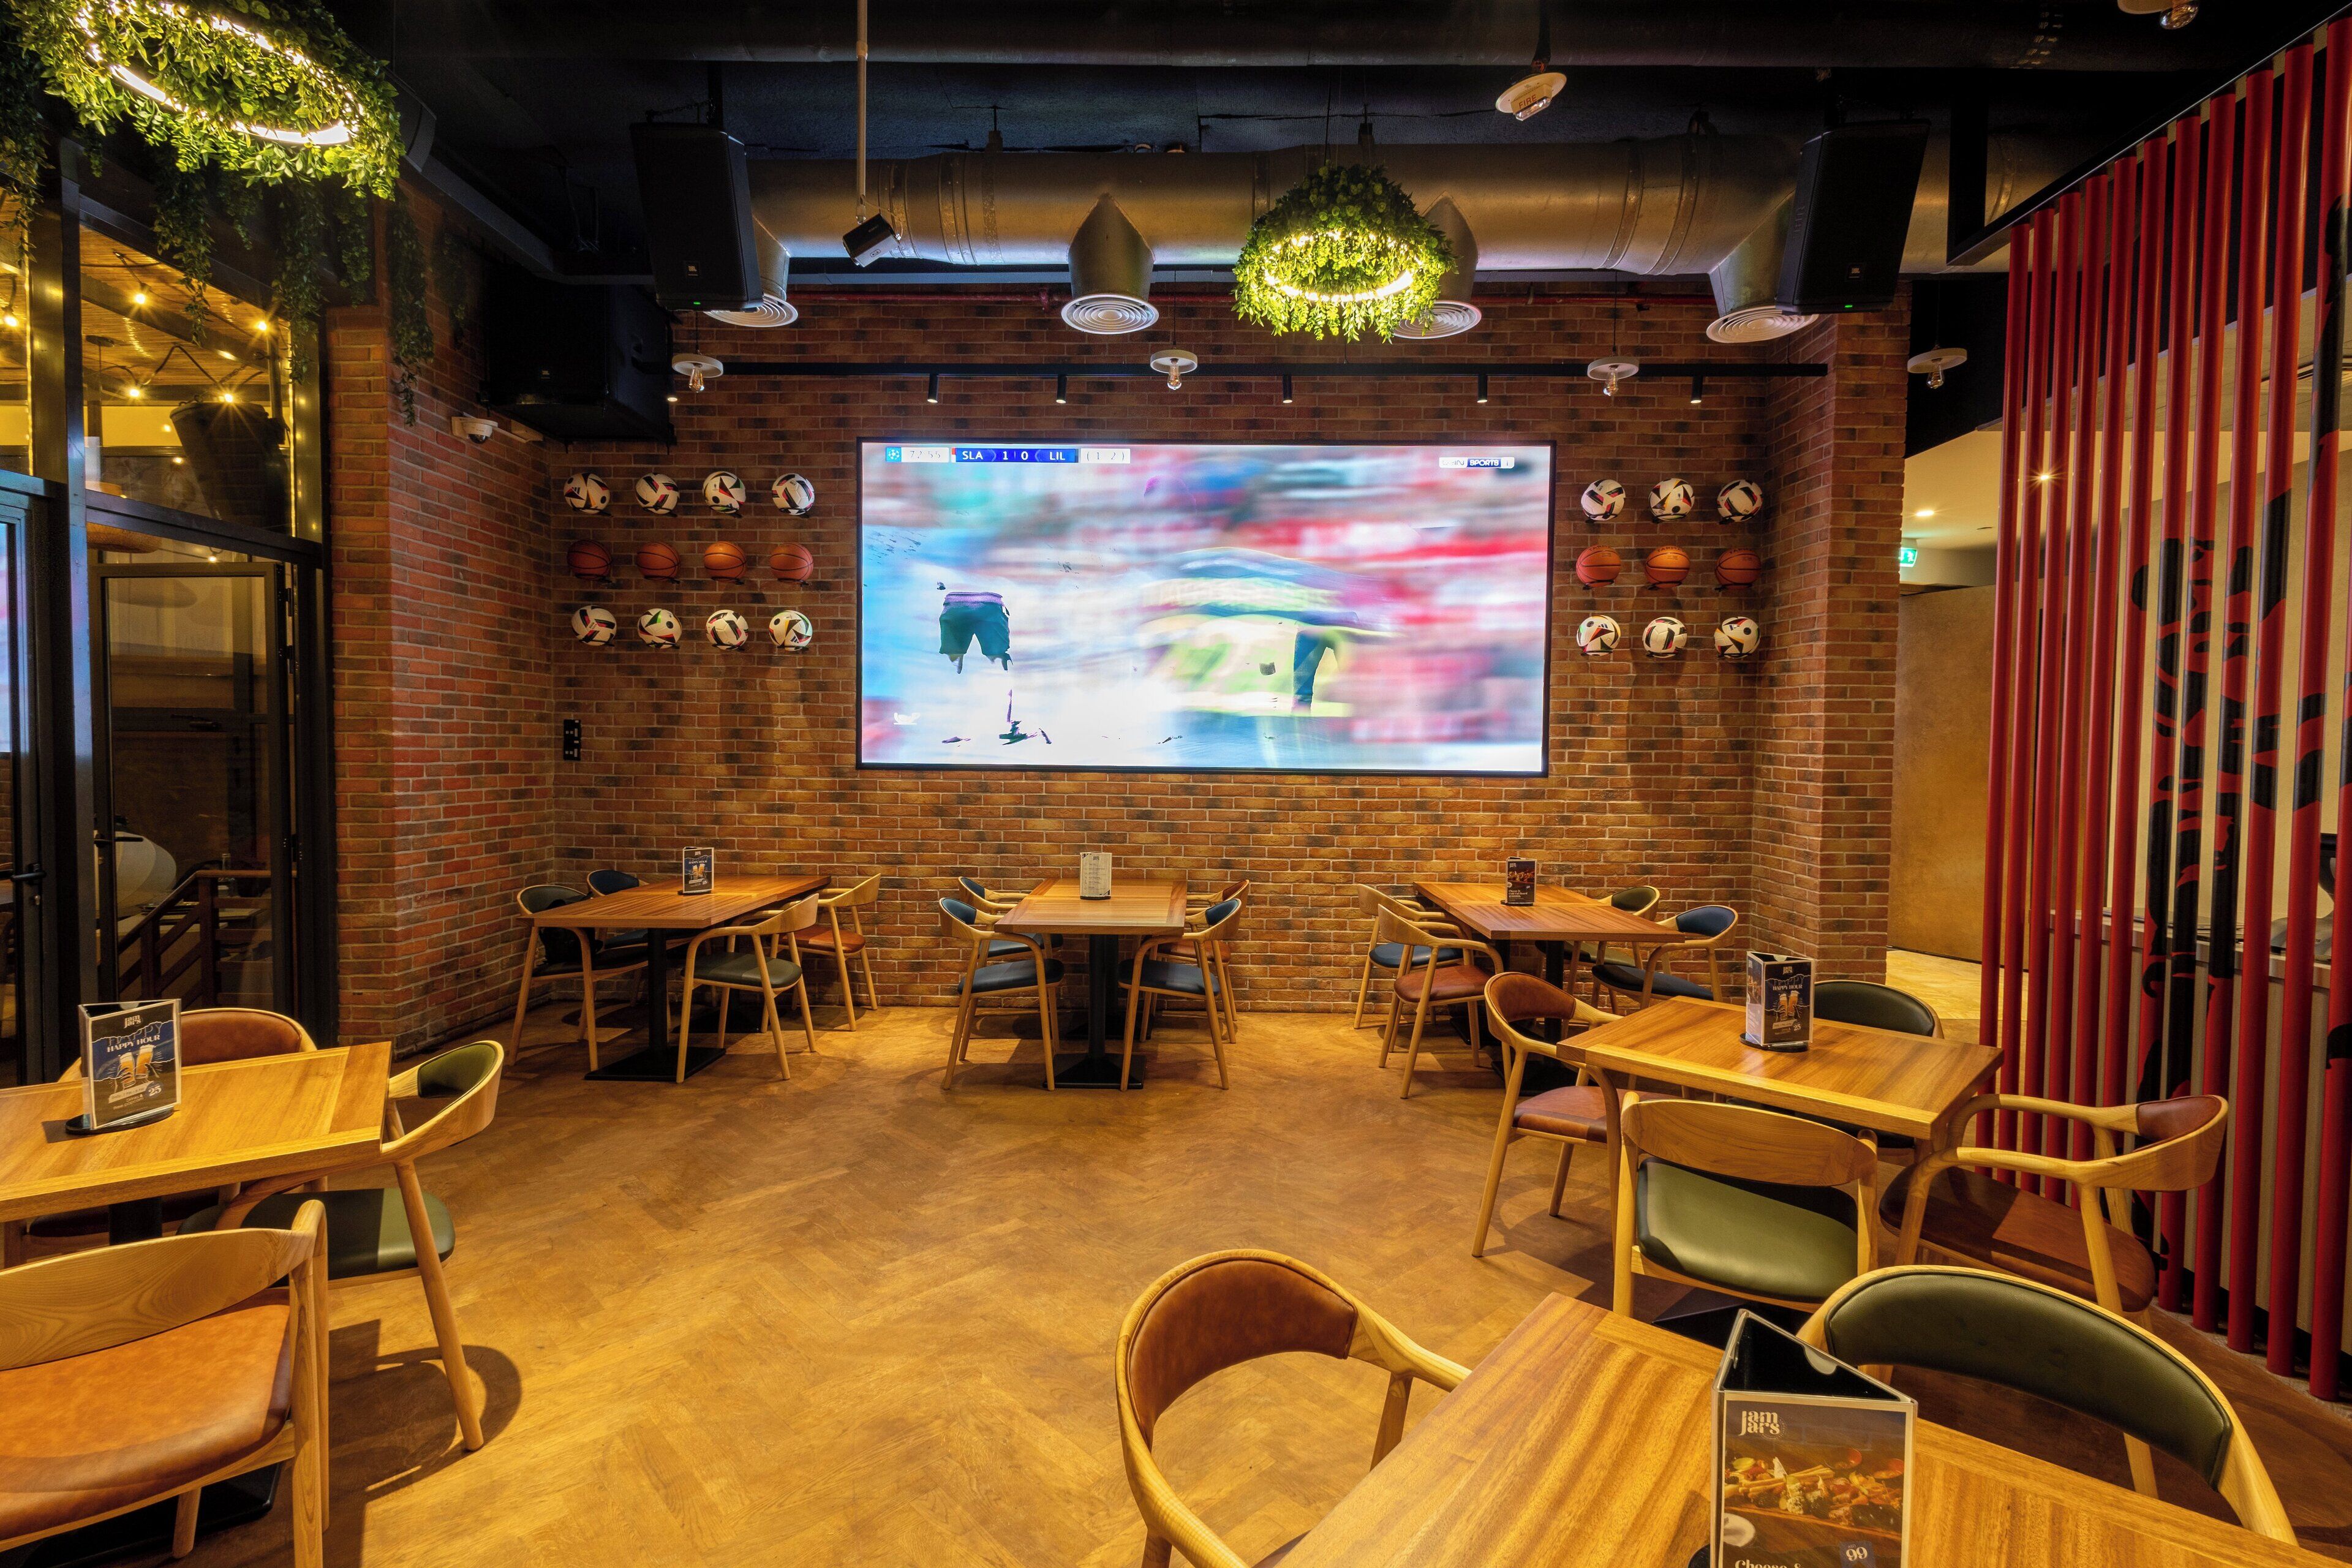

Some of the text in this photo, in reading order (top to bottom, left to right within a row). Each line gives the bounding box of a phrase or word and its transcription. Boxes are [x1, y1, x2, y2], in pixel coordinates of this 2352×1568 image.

[1518, 94, 1537, 109] FIRE
[962, 451, 983, 460] SLA
[1021, 451, 1028, 460] 0
[1049, 452, 1065, 461] LIL
[107, 1035, 160, 1052] HAPPY HOUR
[148, 1085, 162, 1096] 25
[1845, 1546, 1868, 1562] 99
